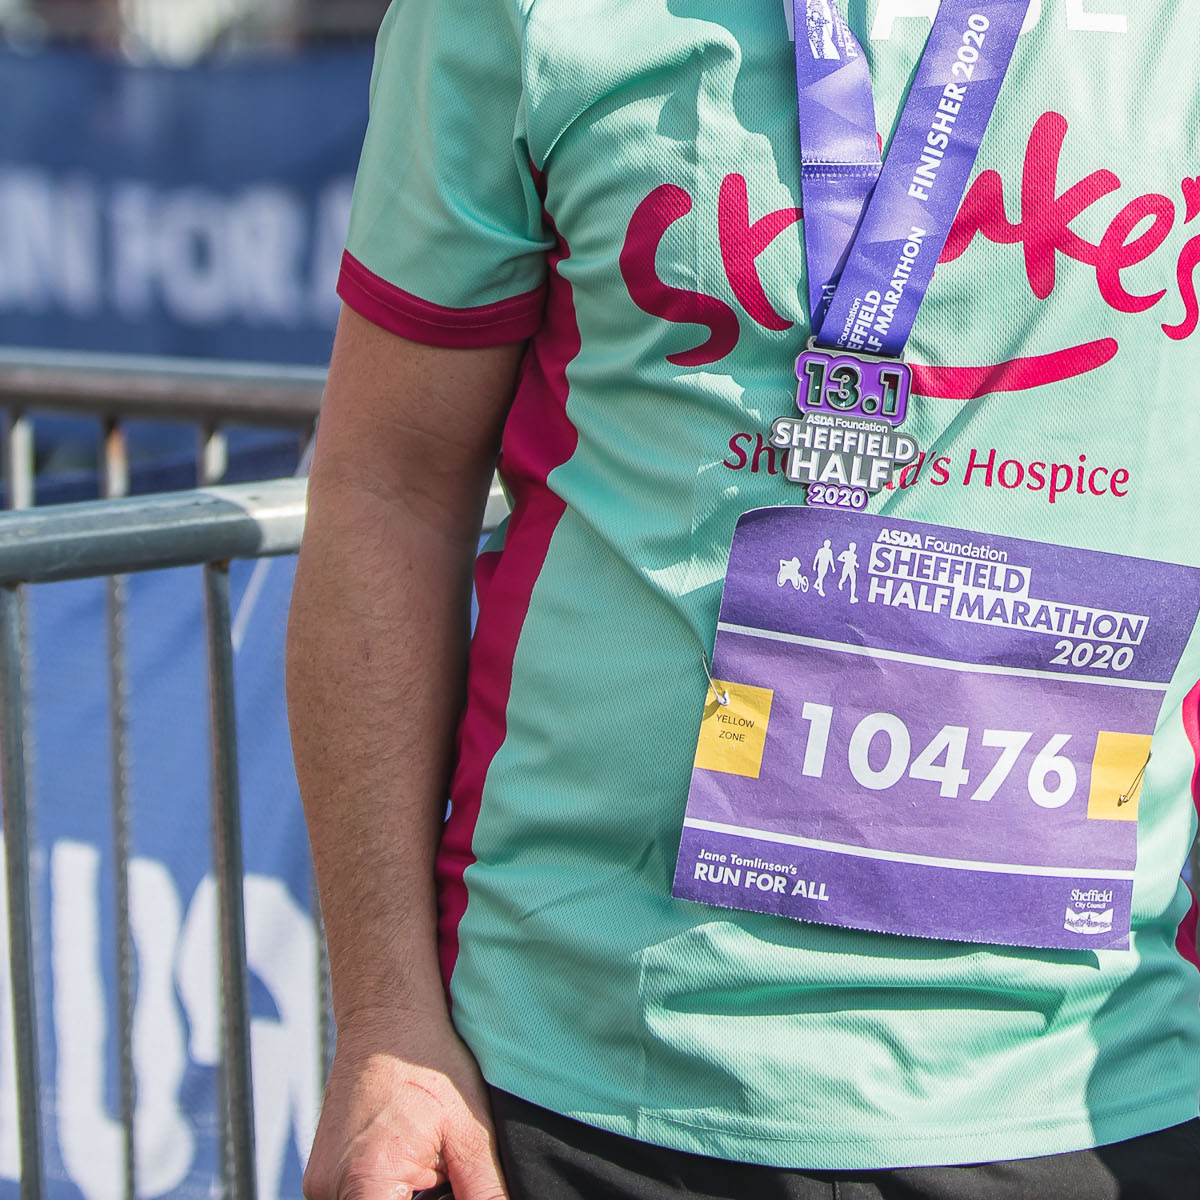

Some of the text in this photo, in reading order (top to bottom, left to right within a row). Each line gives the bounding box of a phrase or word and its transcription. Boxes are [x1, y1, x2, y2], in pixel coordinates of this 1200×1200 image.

[908, 13, 990, 201] FINISHER 2020
[873, 226, 927, 335] MARATHON
[846, 290, 881, 350] EFFIELD
[804, 360, 904, 417] 13.1
[774, 422, 915, 461] SHEFFIELD
[806, 414, 889, 434] ASDA Foundation
[791, 449, 891, 489] HALF
[963, 448, 1131, 503] Hospice
[810, 485, 866, 508] 2020
[877, 528, 1008, 563] ASDA Foundation
[871, 546, 1027, 596] SHEFFIELD
[867, 577, 1145, 643] HALF MARATHON
[1049, 640, 1135, 672] 2020
[716, 714, 755, 729] YELLOW
[718, 730, 746, 743] ZONE
[801, 701, 1077, 809] 10476
[694, 862, 830, 902] RUN FOR ALL
[698, 849, 798, 876] Jane Tomlinson's
[1070, 889, 1113, 903] Sheffield
